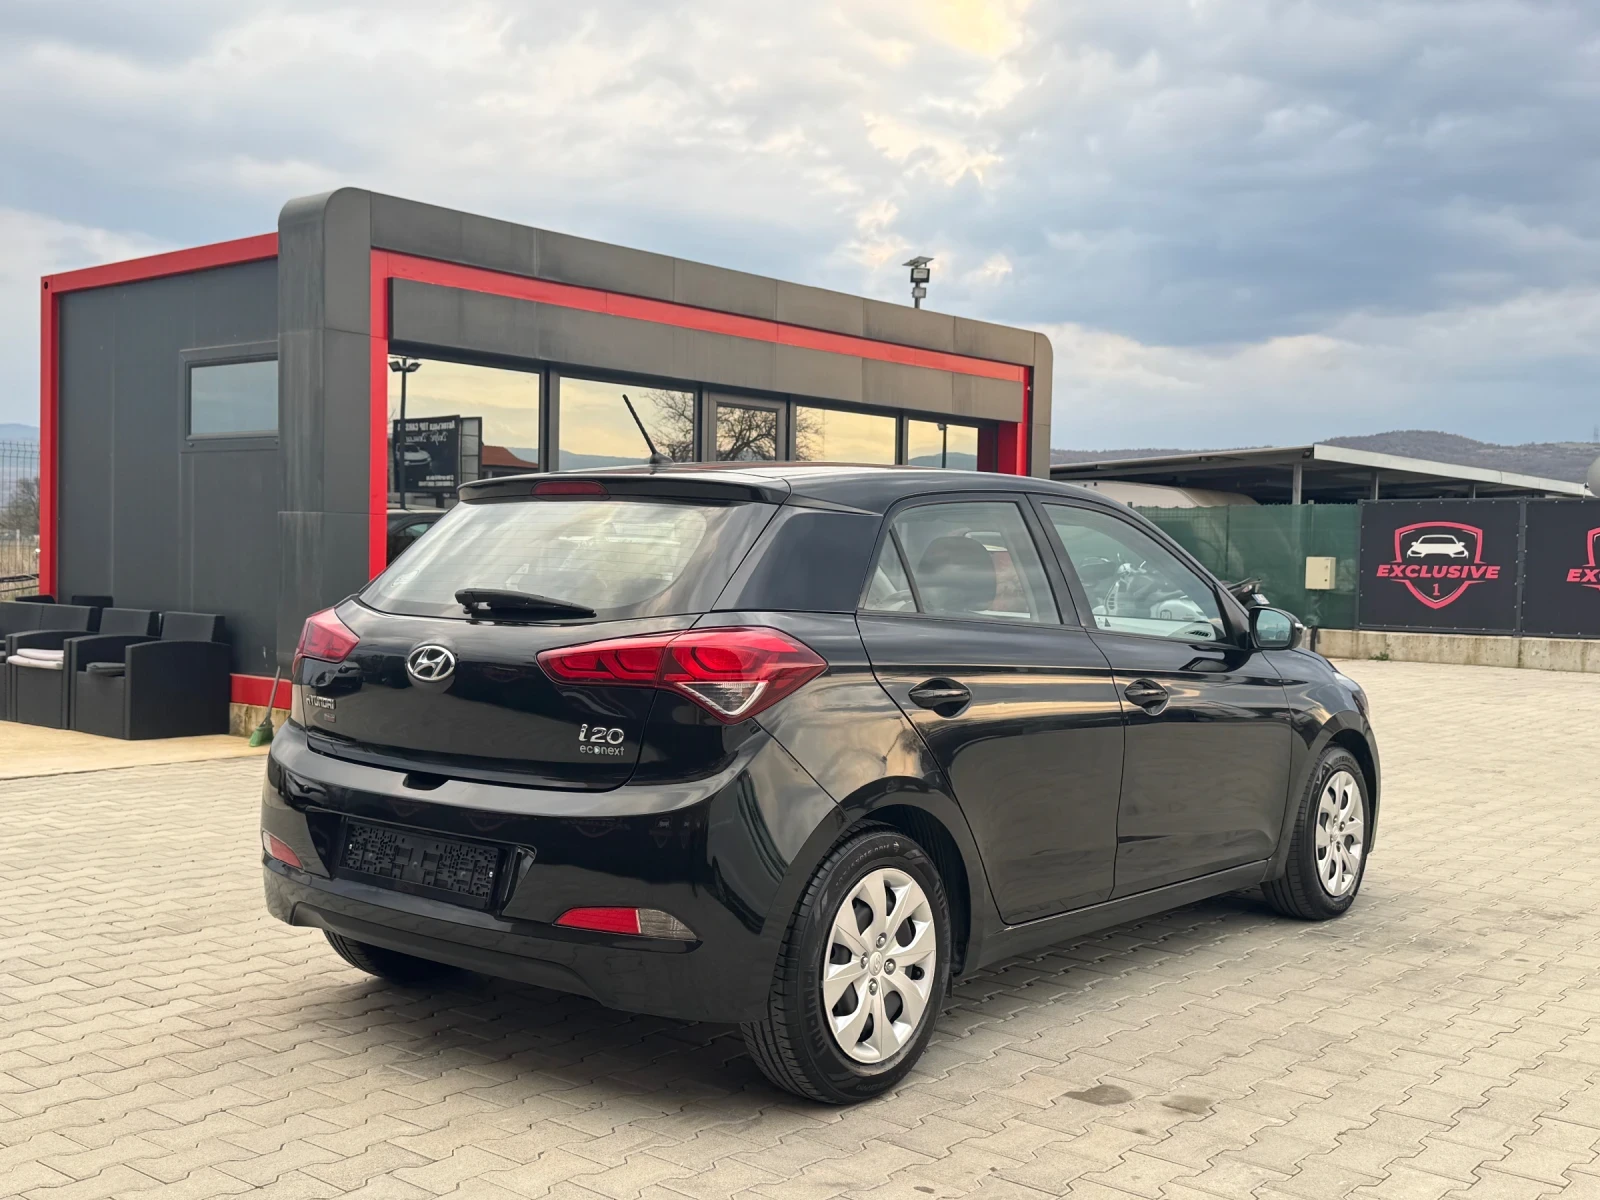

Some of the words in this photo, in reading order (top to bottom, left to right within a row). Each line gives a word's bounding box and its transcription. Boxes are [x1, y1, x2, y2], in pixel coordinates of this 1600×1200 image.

[1376, 564, 1501, 579] EXCLUSIVE
[1566, 568, 1600, 582] EX
[1432, 583, 1440, 596] 1
[578, 723, 624, 745] i20
[579, 745, 625, 756] econext
